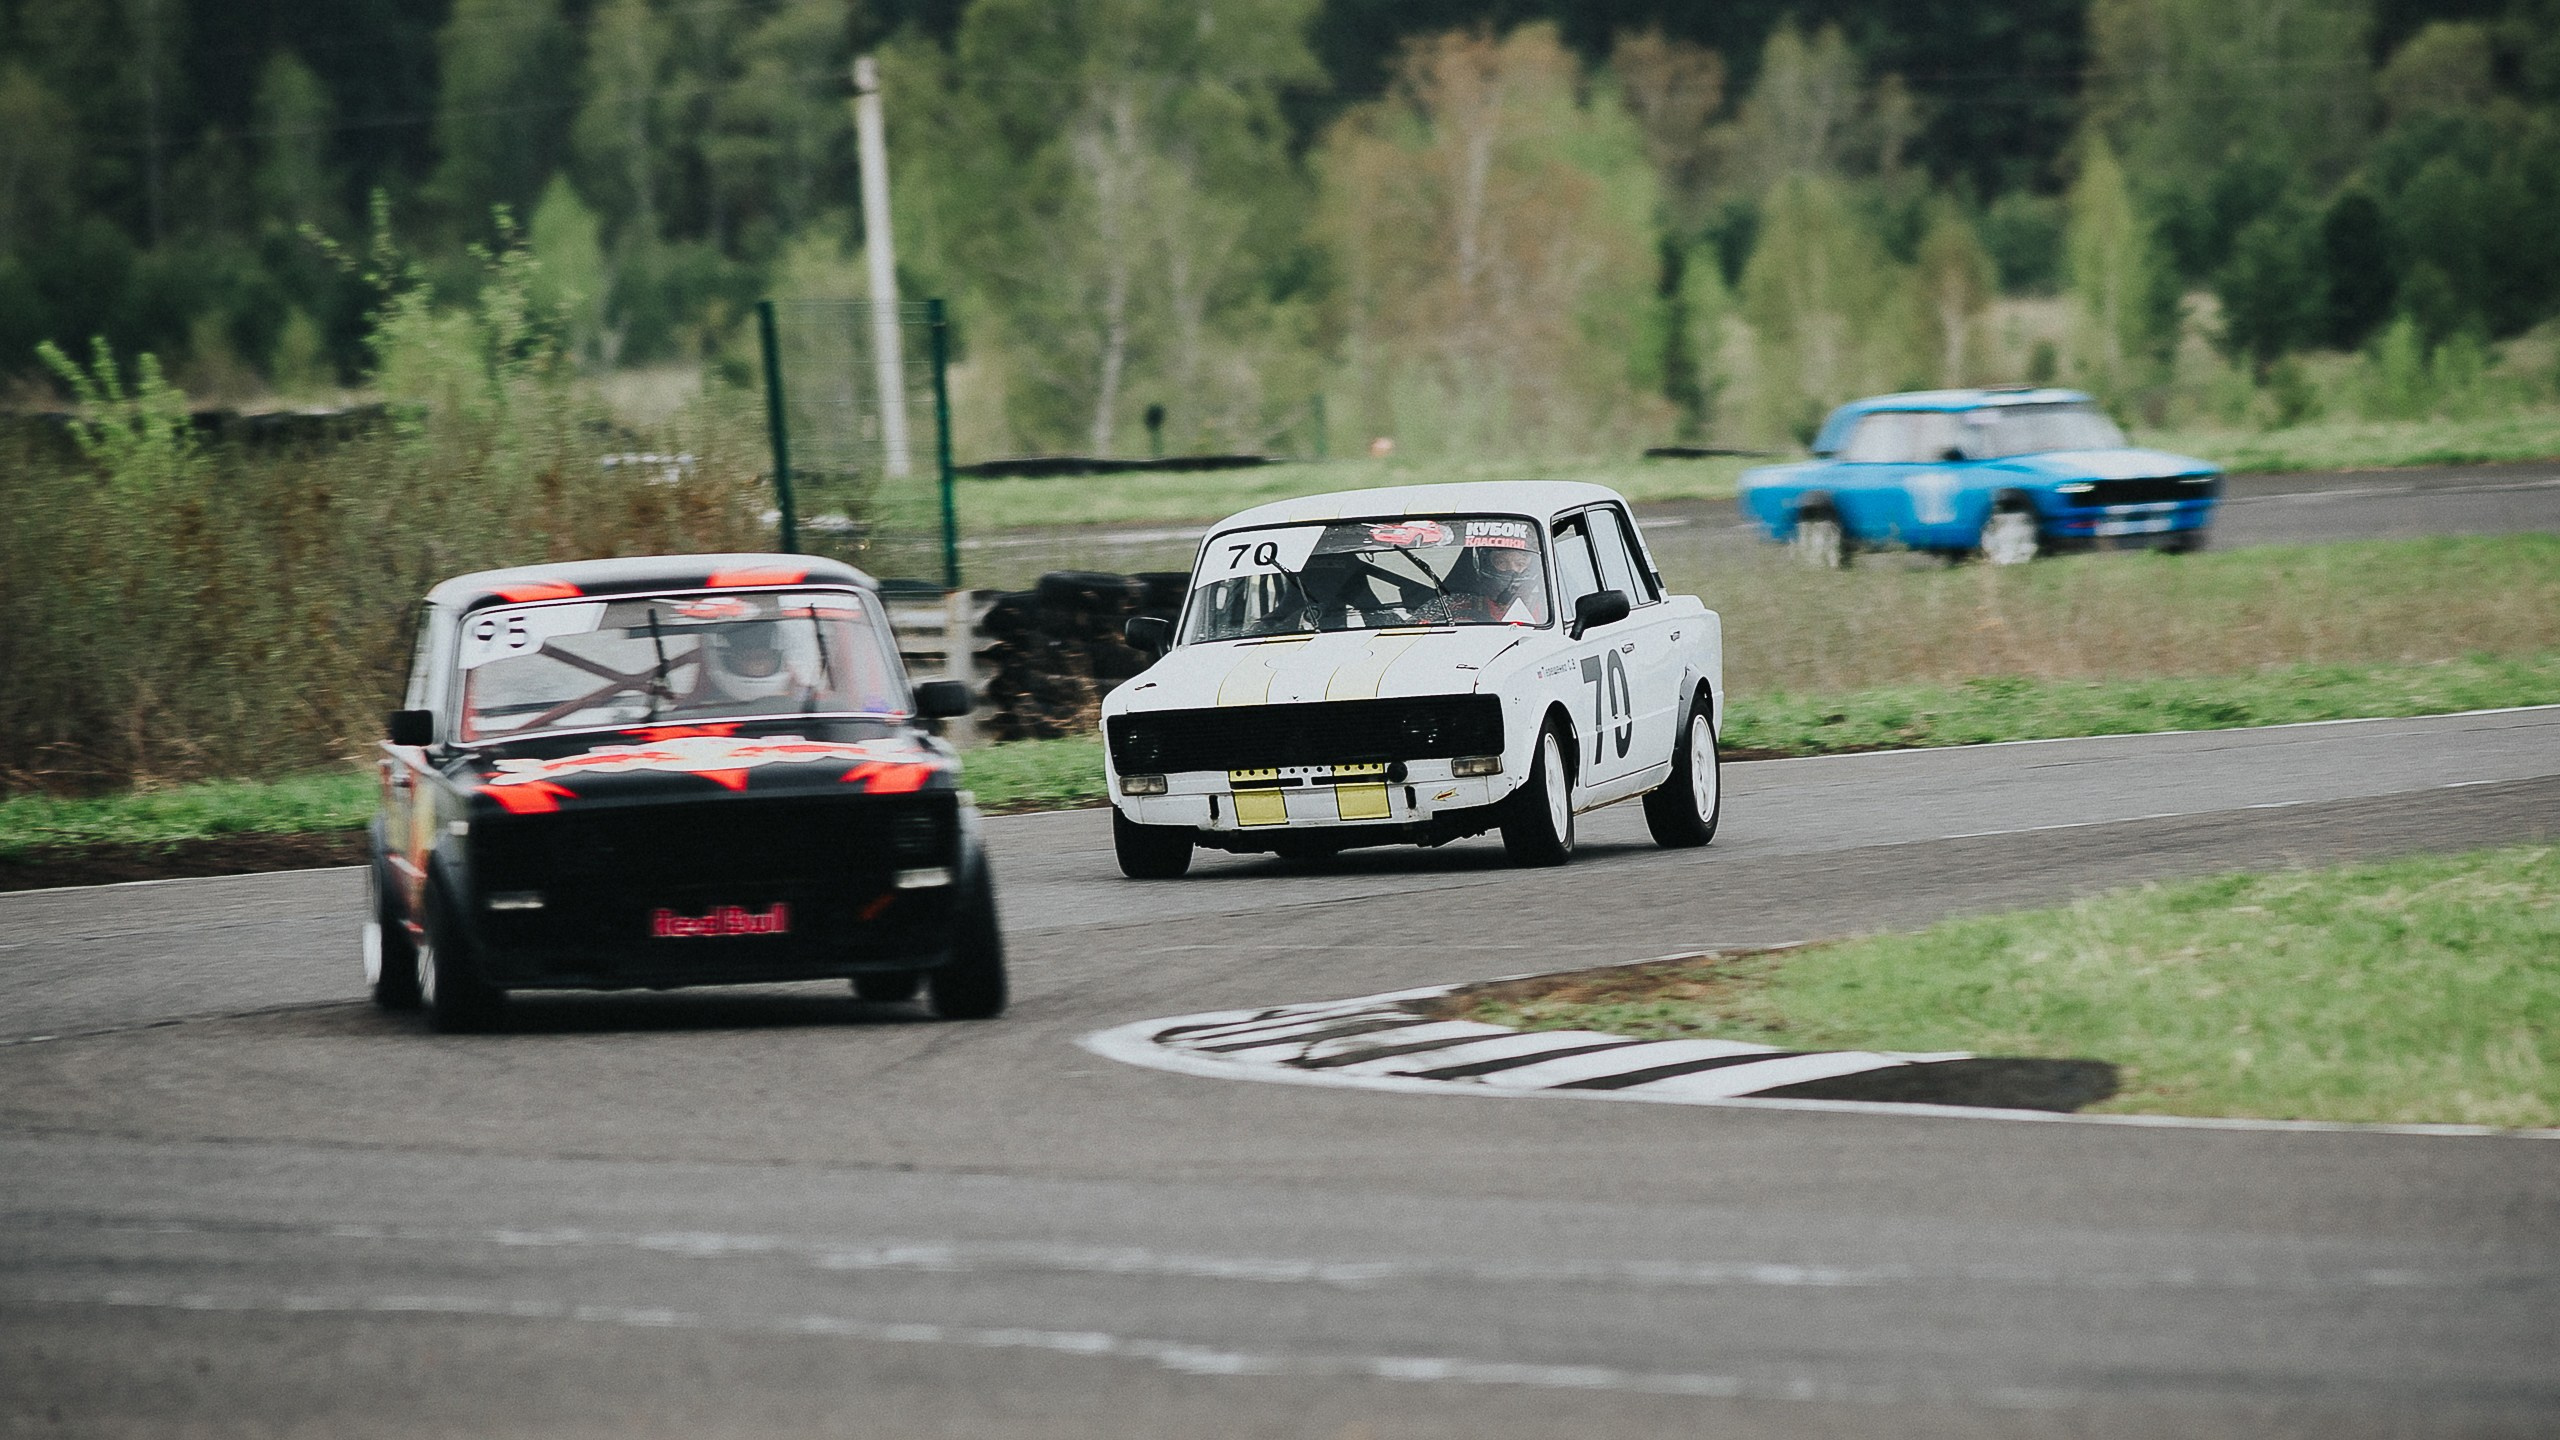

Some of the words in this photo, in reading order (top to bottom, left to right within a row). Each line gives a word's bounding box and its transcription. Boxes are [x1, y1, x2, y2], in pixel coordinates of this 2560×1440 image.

[1465, 522, 1527, 538] КУБОК
[1228, 542, 1278, 569] 70
[1580, 649, 1632, 765] 70
